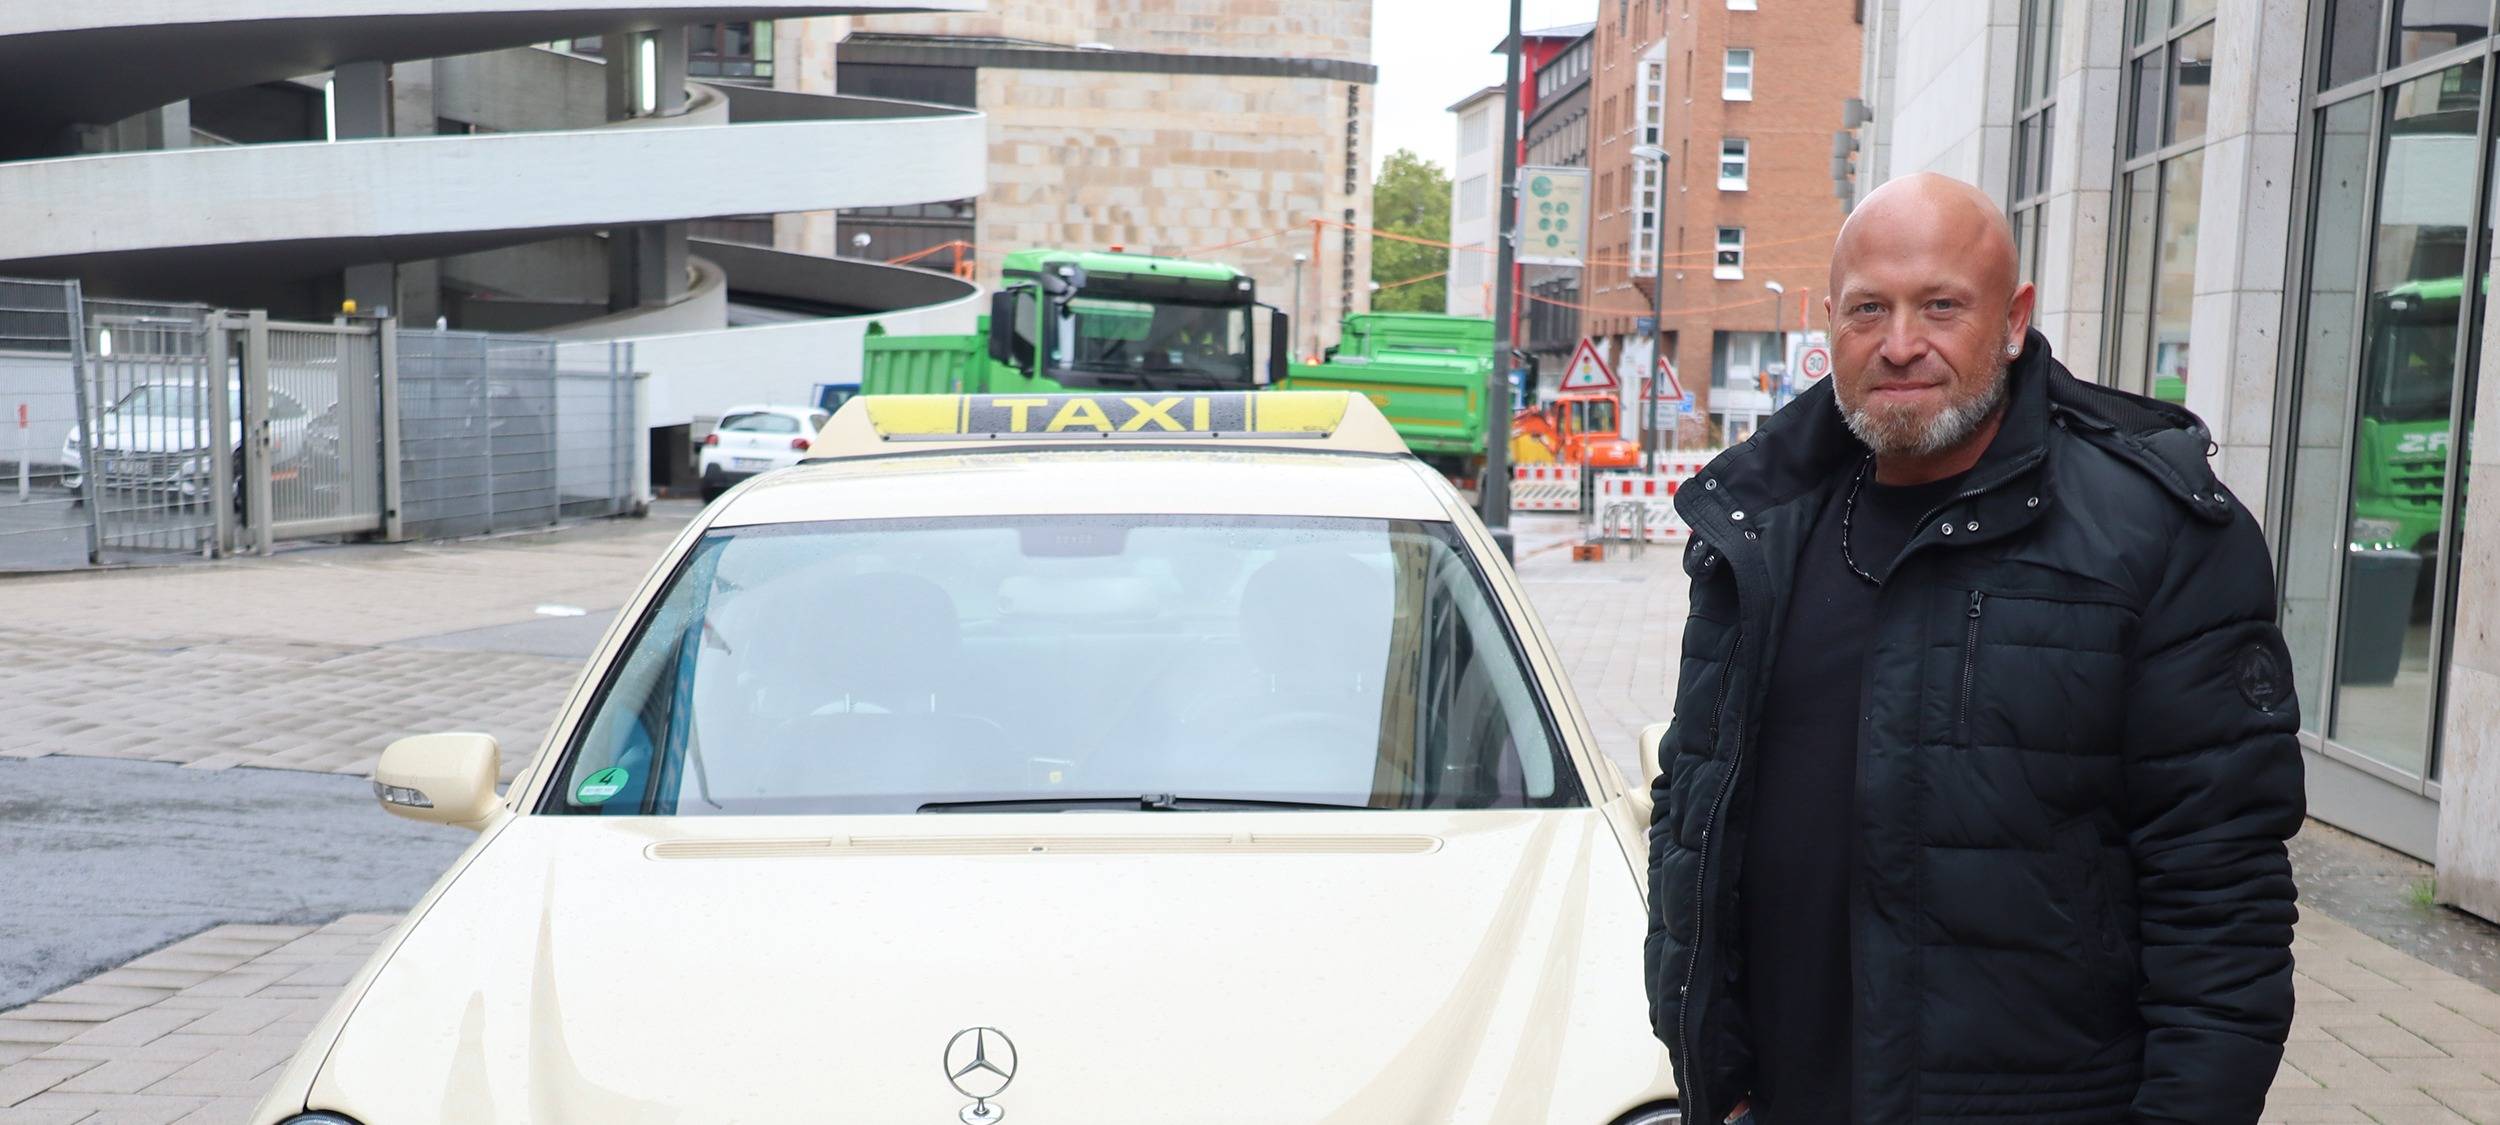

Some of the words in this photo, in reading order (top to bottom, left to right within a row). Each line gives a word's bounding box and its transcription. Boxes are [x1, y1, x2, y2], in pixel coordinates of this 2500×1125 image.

[1807, 357, 1824, 371] 30
[992, 397, 1210, 432] TAXI
[599, 768, 617, 785] 4
